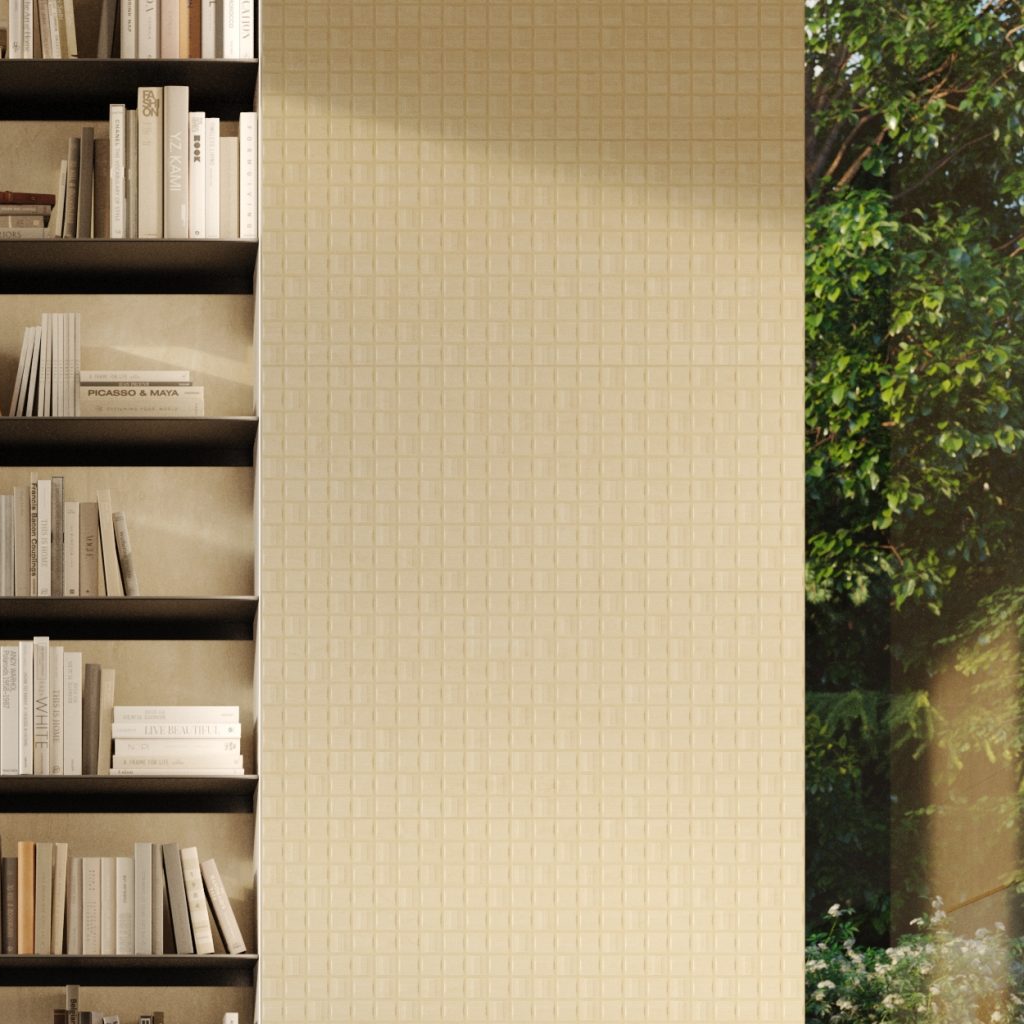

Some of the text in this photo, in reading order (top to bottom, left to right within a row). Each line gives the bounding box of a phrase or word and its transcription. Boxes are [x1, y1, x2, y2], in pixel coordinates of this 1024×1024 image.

[169, 155, 183, 191] KAMI
[88, 389, 179, 397] PICASSO & MAYA
[35, 697, 48, 749] WHITE
[144, 725, 221, 735] LIVE BEAUTIFUL
